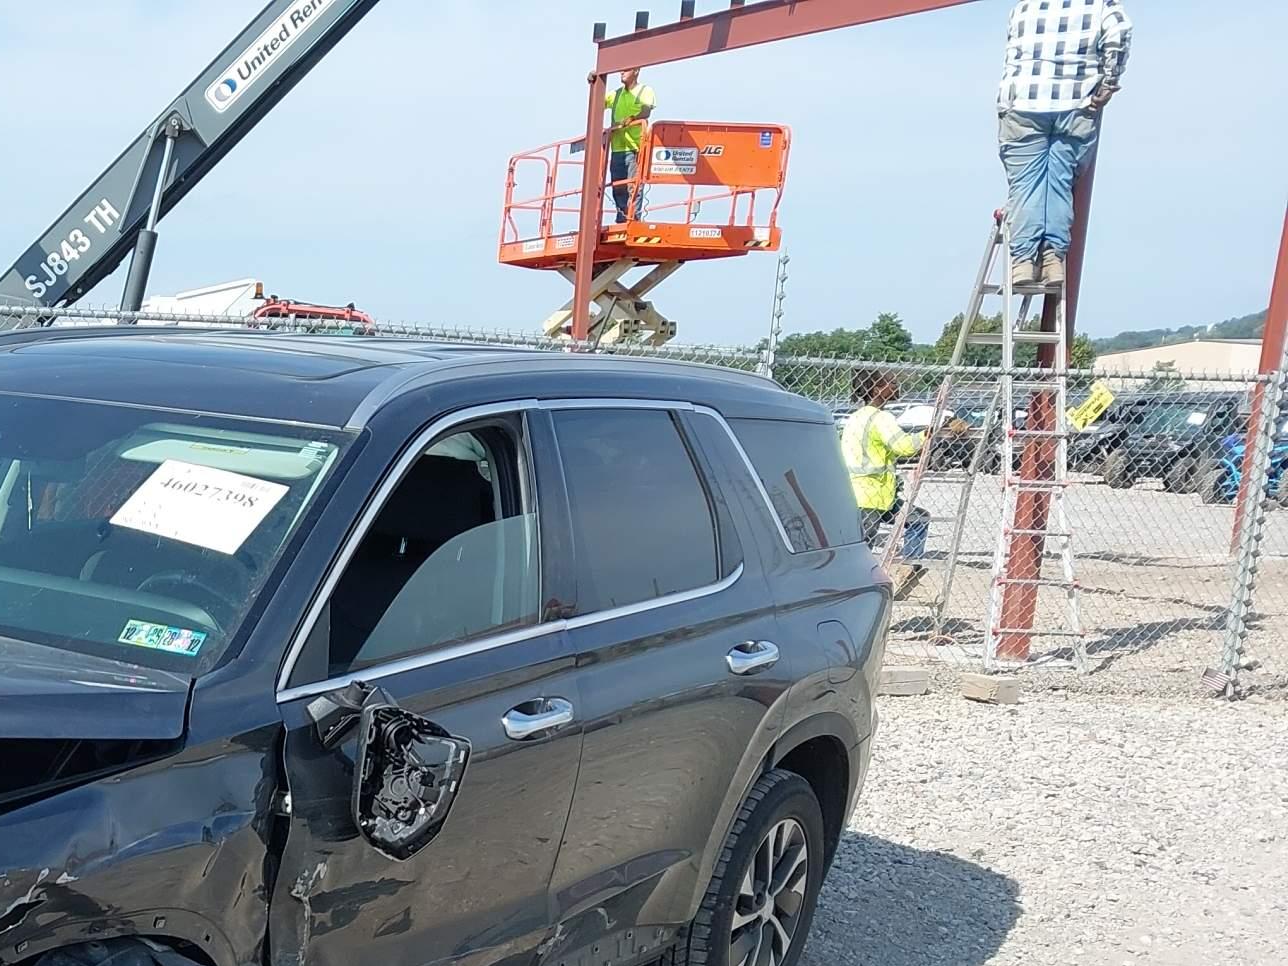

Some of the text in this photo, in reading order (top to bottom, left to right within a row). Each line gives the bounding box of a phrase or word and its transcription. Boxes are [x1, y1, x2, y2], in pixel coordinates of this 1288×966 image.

[237, 23, 290, 81] United
[701, 146, 722, 155] JLG
[25, 199, 120, 298] SJ843 TH
[161, 477, 259, 508] 46027398
[121, 627, 137, 641] 12
[184, 639, 200, 652] 12
